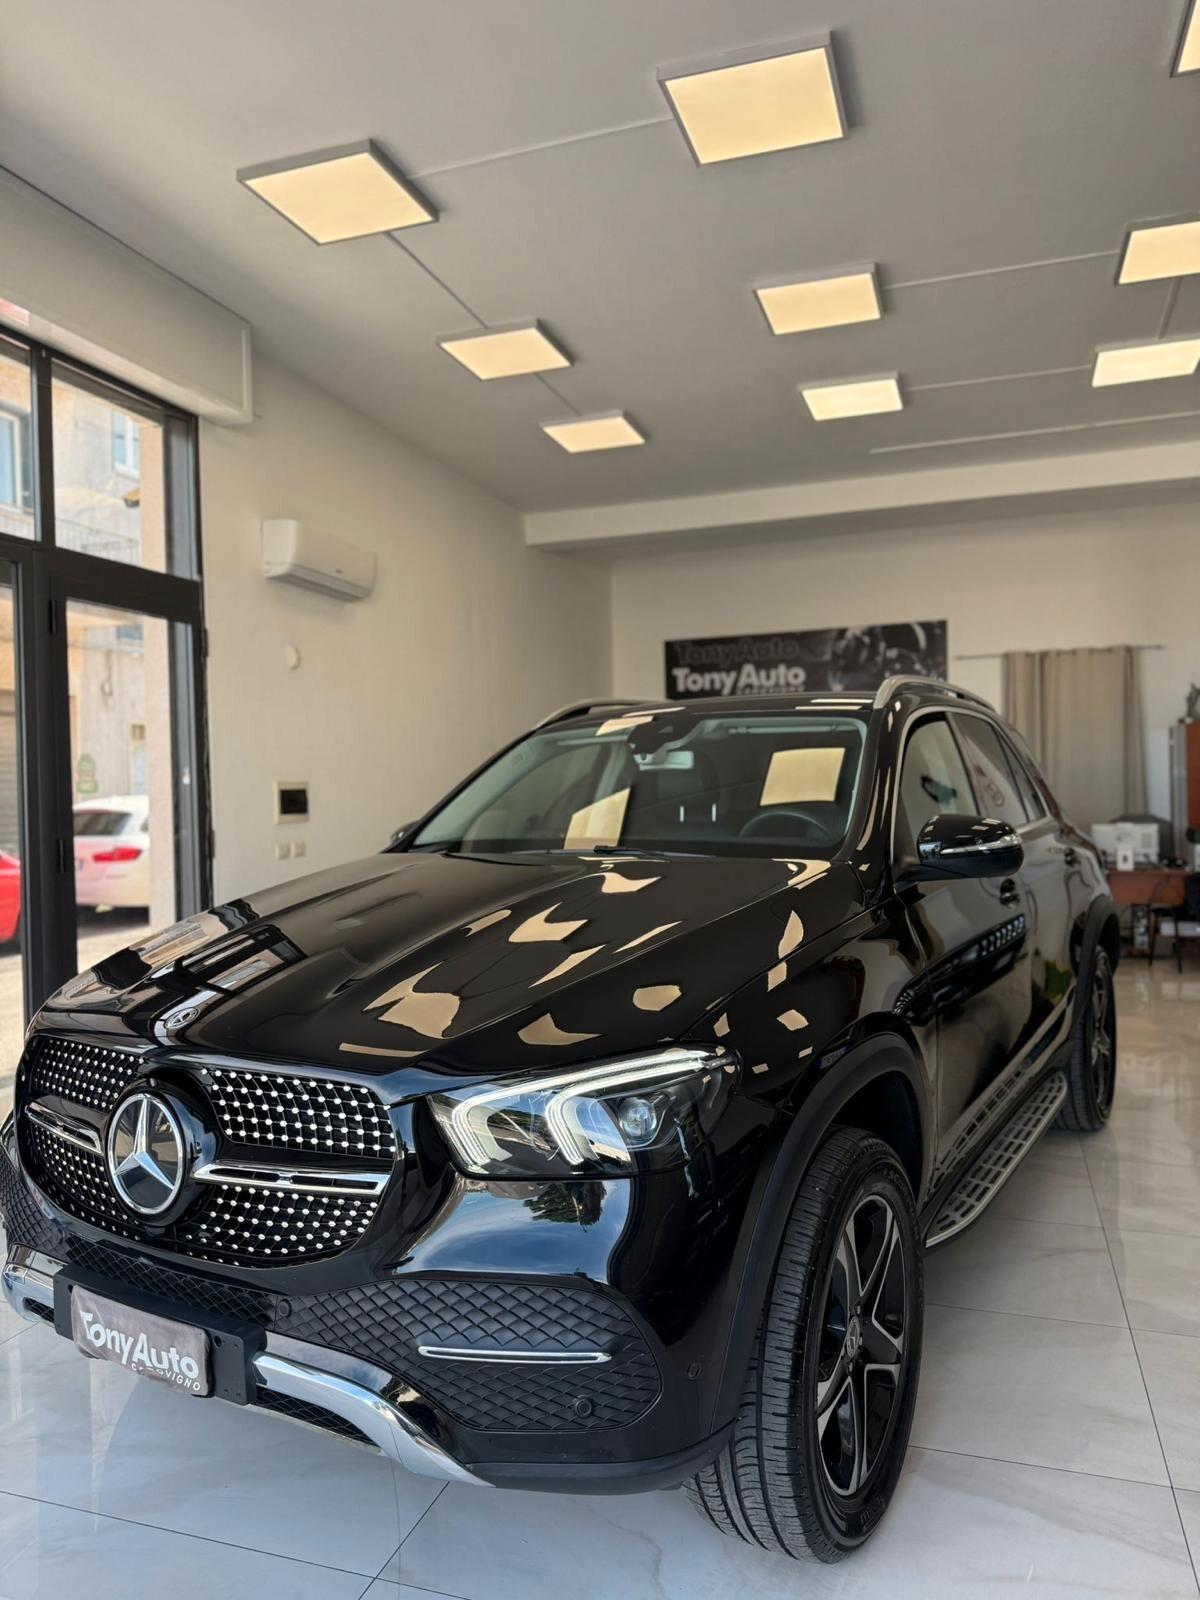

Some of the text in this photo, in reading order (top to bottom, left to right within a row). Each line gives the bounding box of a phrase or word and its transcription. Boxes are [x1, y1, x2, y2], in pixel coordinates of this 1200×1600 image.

[675, 638, 799, 667] TonyAuto
[672, 663, 806, 695] TonyAuto
[81, 1311, 199, 1379] TonyAuto
[131, 1363, 200, 1391] COVIGNO
